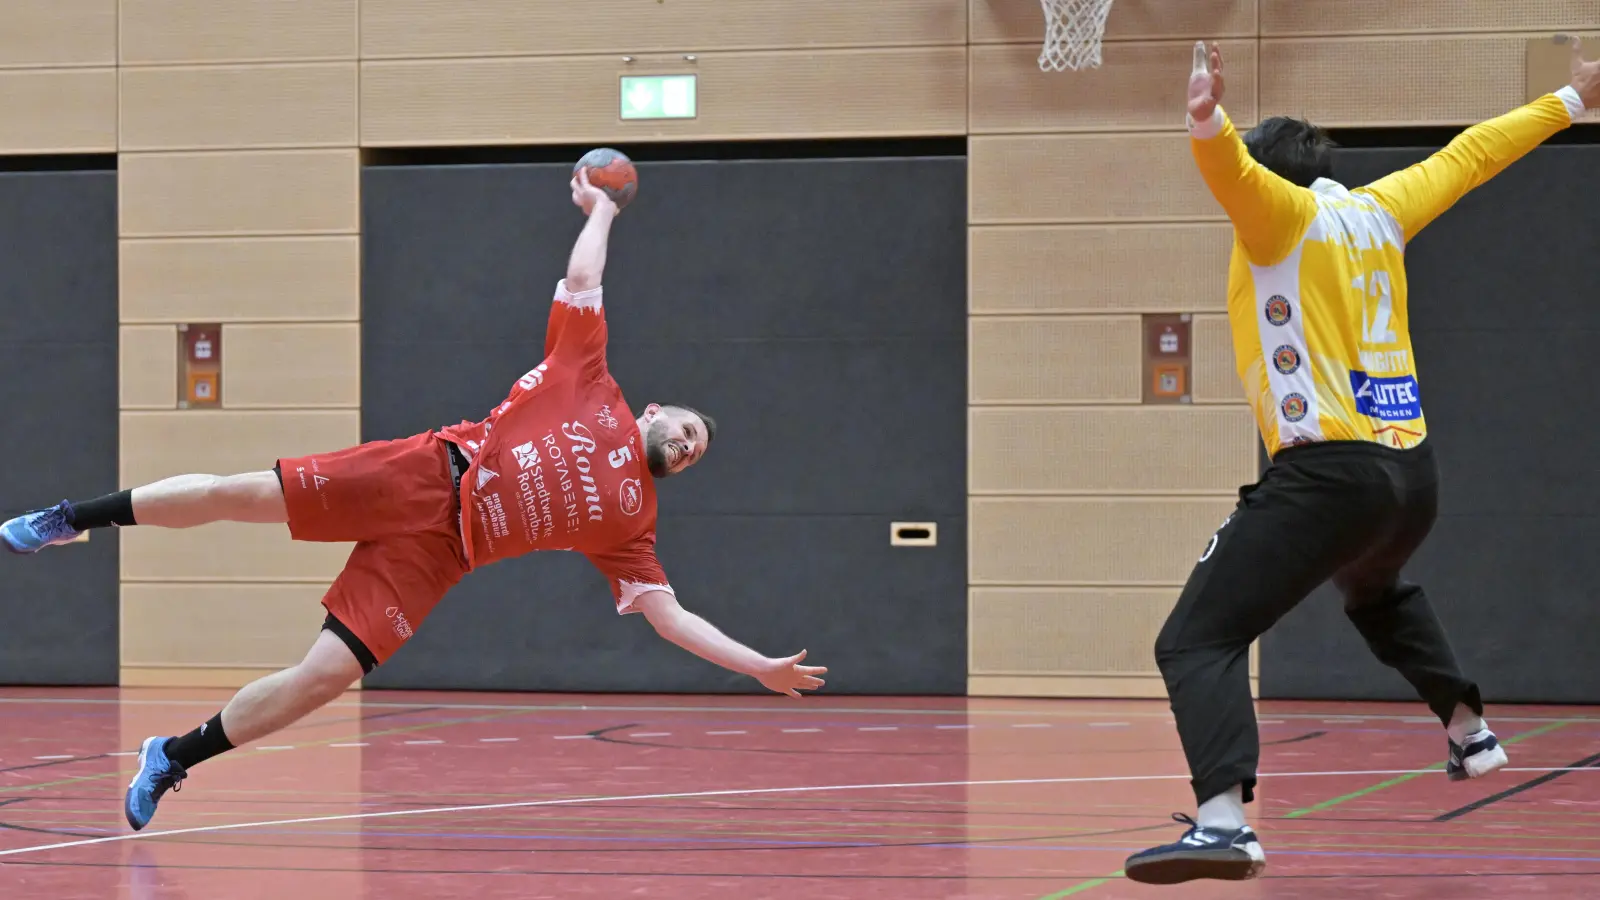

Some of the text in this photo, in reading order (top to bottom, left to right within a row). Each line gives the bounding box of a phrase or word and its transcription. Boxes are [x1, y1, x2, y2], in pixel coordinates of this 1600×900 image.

[1352, 270, 1397, 343] 12
[1370, 405, 1413, 418] MNCHEN
[542, 432, 580, 534] ROTABENE!
[562, 420, 603, 522] Roma
[608, 445, 632, 469] 5
[484, 495, 501, 538] geissbauer
[492, 492, 510, 536] engelhardt
[530, 465, 553, 538] Stadtwerke
